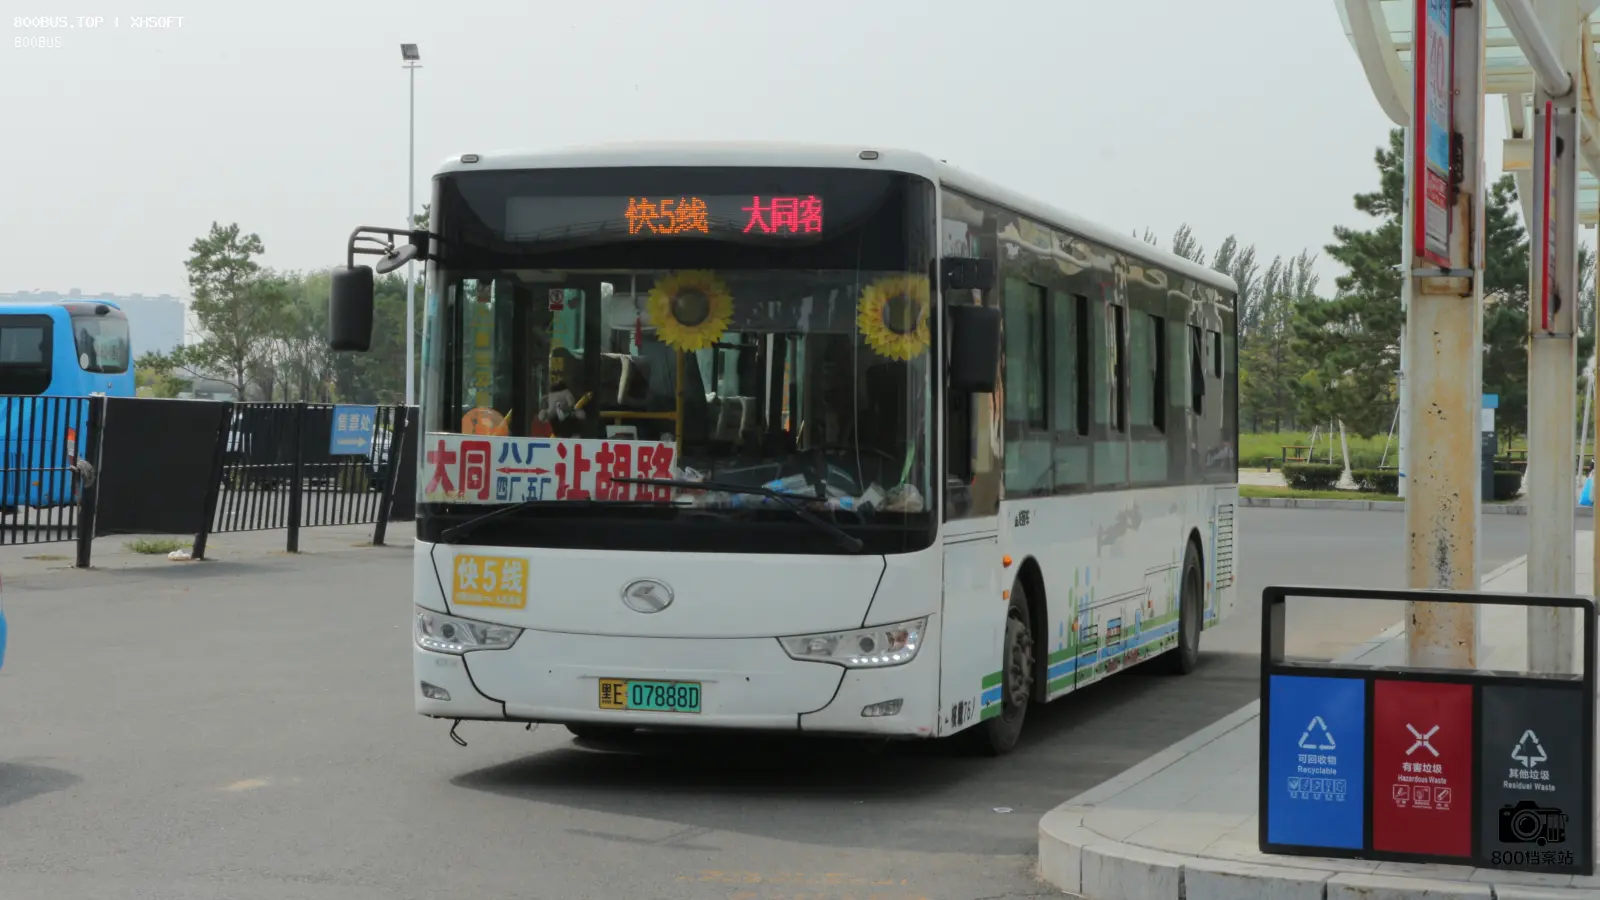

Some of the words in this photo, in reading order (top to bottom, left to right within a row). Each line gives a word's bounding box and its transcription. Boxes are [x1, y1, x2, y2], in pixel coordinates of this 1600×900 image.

[625, 197, 708, 234] 快5线
[741, 196, 822, 233] 大同客
[498, 442, 551, 465] 八厂
[425, 440, 491, 500] 大同
[555, 442, 674, 501] 让胡路
[457, 557, 523, 593] 快5线
[1298, 754, 1337, 765] 可回收物
[1297, 765, 1337, 775] Recyclable
[1402, 761, 1443, 773] 有害垃圾
[1397, 774, 1428, 784] Hazardous
[1428, 776, 1447, 784] Waste
[1508, 768, 1550, 781] 其他垃圾
[1503, 780, 1533, 790] Residual
[1534, 783, 1556, 792] Waste
